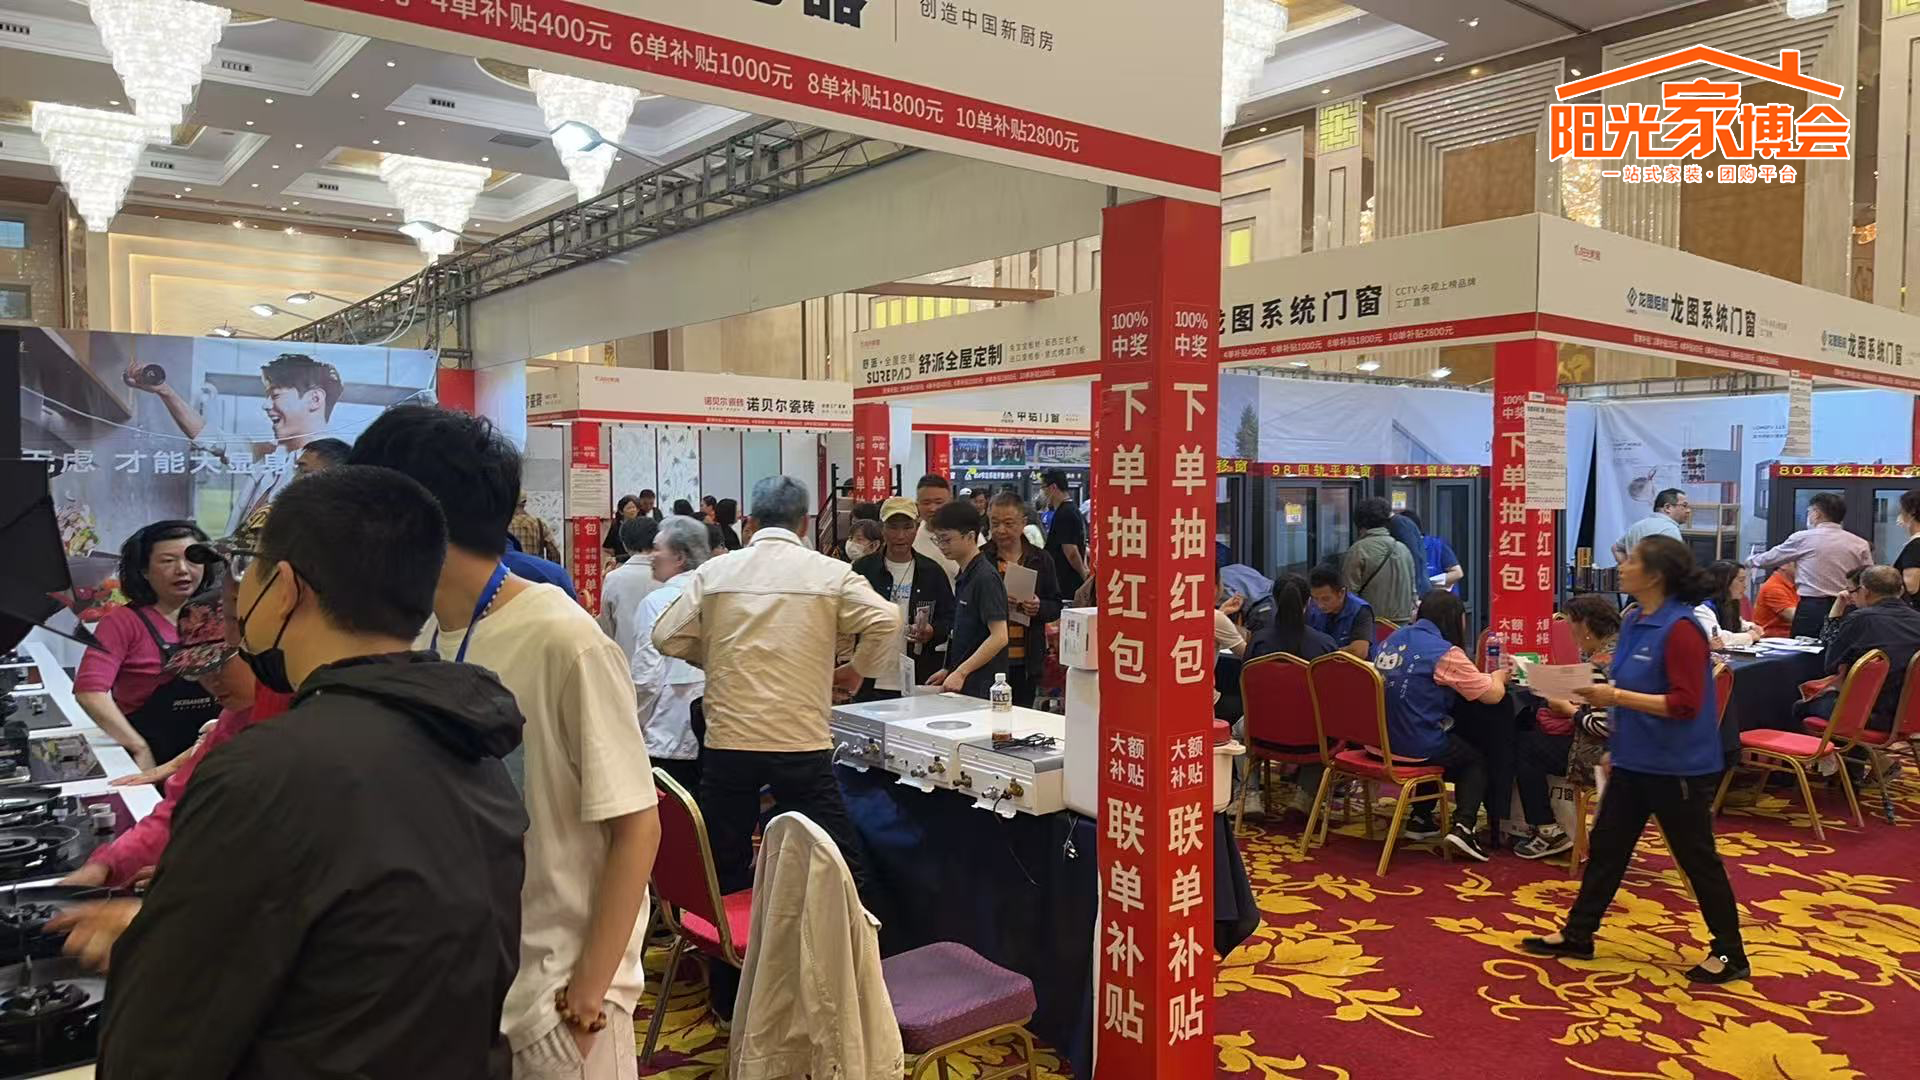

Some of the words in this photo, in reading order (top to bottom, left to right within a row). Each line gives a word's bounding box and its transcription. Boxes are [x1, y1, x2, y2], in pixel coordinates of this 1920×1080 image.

[920, 0, 1055, 52] 创造中国新厨房
[630, 31, 793, 90] 6单补贴1000元
[807, 72, 944, 123] 8单补贴1800元
[956, 107, 1080, 153] 10单补贴2800元
[1111, 311, 1148, 330] 100%
[1175, 311, 1208, 330] 100%
[1671, 292, 1756, 338] 龙图系统门窗
[918, 343, 1003, 375] 舒派全屋定制
[1112, 333, 1148, 359] 中奖
[1175, 333, 1208, 359] 中奖
[867, 367, 912, 384] SUREPAD
[747, 396, 815, 414] 诺贝尔瓷砖
[1272, 464, 1291, 476] 98
[1394, 465, 1421, 476] 115
[1779, 466, 1803, 476] 80
[1499, 432, 1526, 591] 下单抽红包
[1107, 381, 1150, 684] 下单抽红包
[1170, 382, 1208, 685] 下单抽红包
[1109, 733, 1145, 760] 大额
[1171, 735, 1203, 763] 大额
[1109, 758, 1145, 788] 补贴
[1170, 760, 1203, 789] 补贴
[1105, 797, 1145, 1045] 联单补贴
[1168, 802, 1205, 1046] 联单补贴
